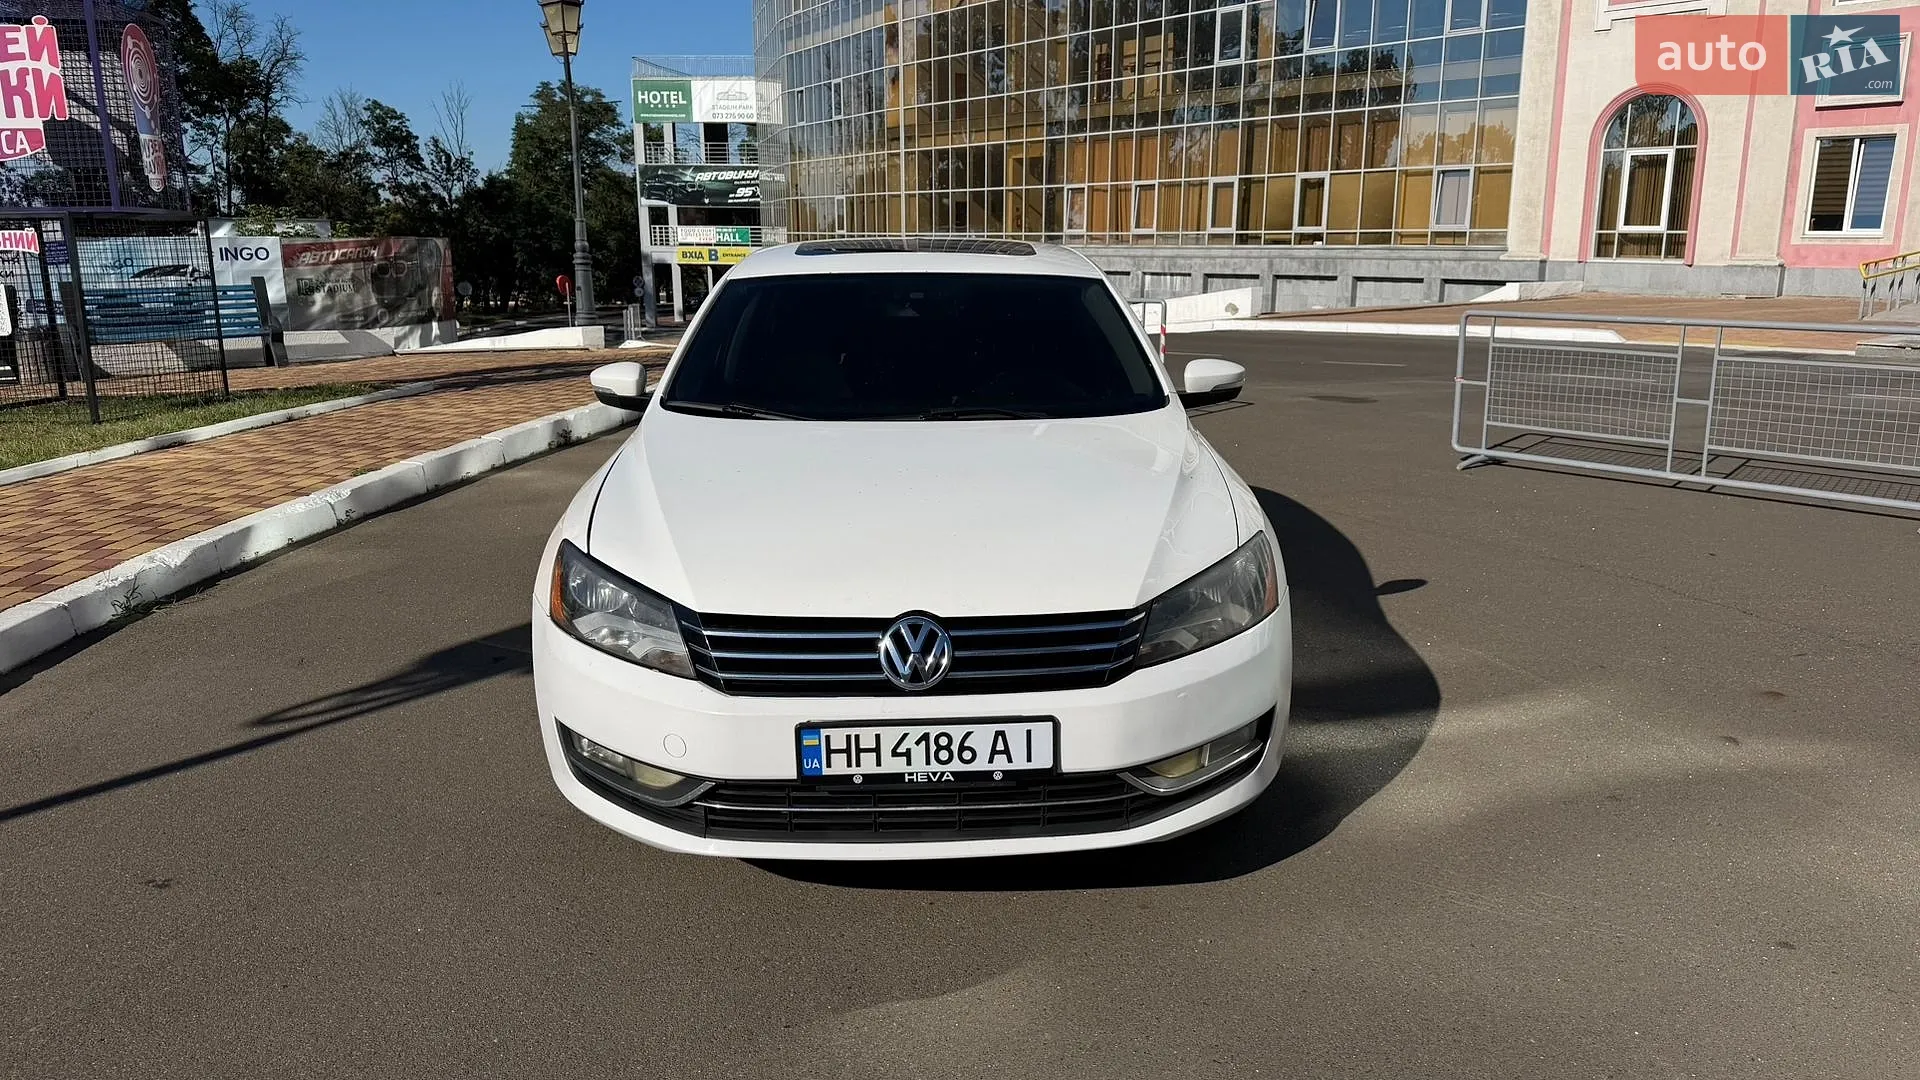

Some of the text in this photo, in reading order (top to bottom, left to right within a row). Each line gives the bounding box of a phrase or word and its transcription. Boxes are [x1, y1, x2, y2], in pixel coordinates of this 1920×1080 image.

[0, 66, 68, 119] КИ
[637, 90, 687, 105] HOTEL
[0, 130, 32, 155] СА
[0, 228, 39, 253] НИЙ
[716, 232, 742, 242] HALL
[219, 246, 270, 262] INGO
[824, 733, 882, 769] HH
[890, 731, 978, 767] 4186
[804, 758, 820, 769] UA
